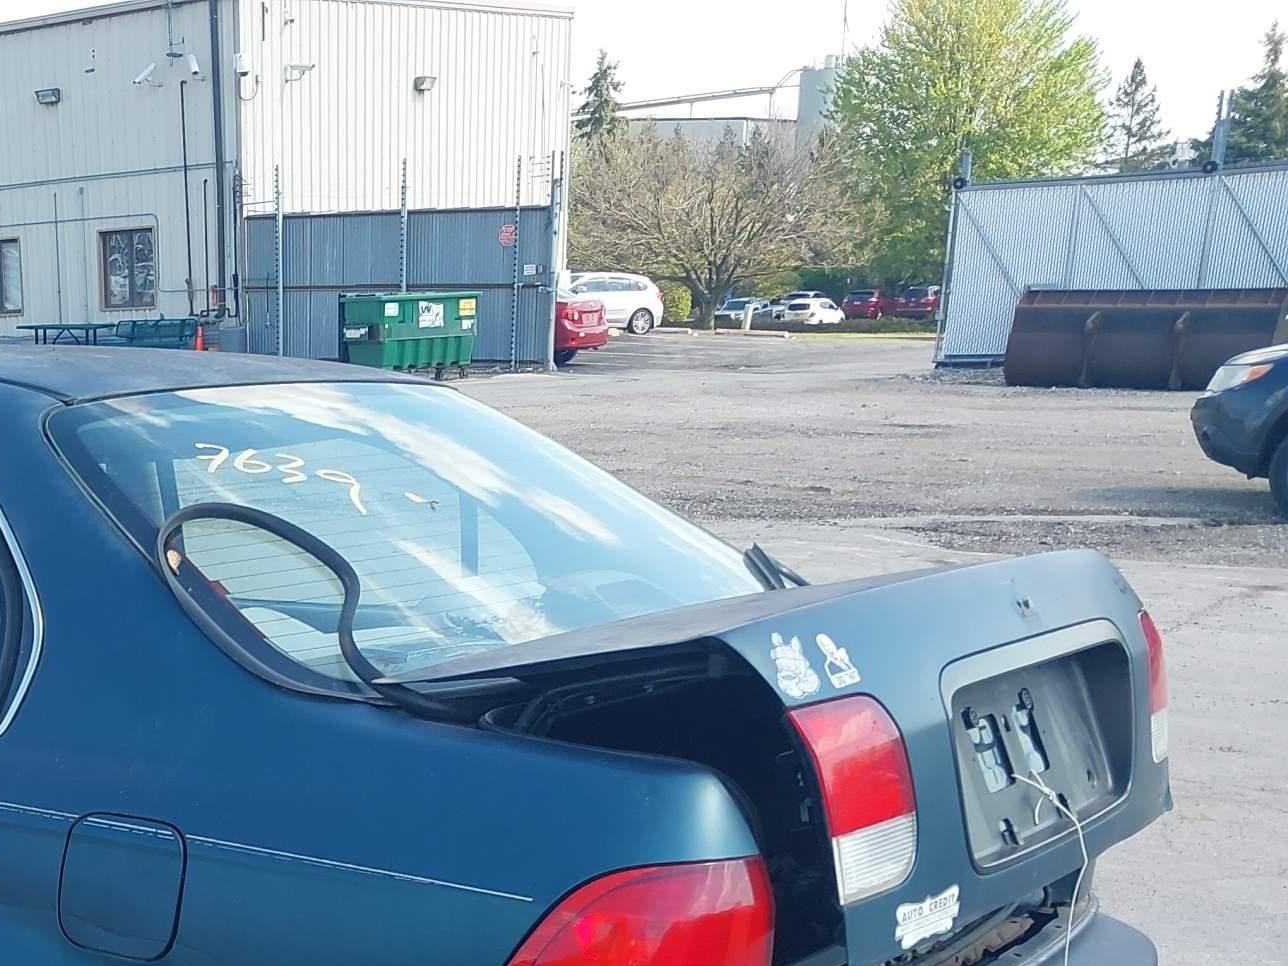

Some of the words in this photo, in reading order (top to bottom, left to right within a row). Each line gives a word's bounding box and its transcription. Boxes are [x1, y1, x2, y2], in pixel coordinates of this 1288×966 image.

[193, 442, 367, 516] 7639
[902, 906, 924, 922] AUTO
[929, 893, 956, 912] CREDIT
